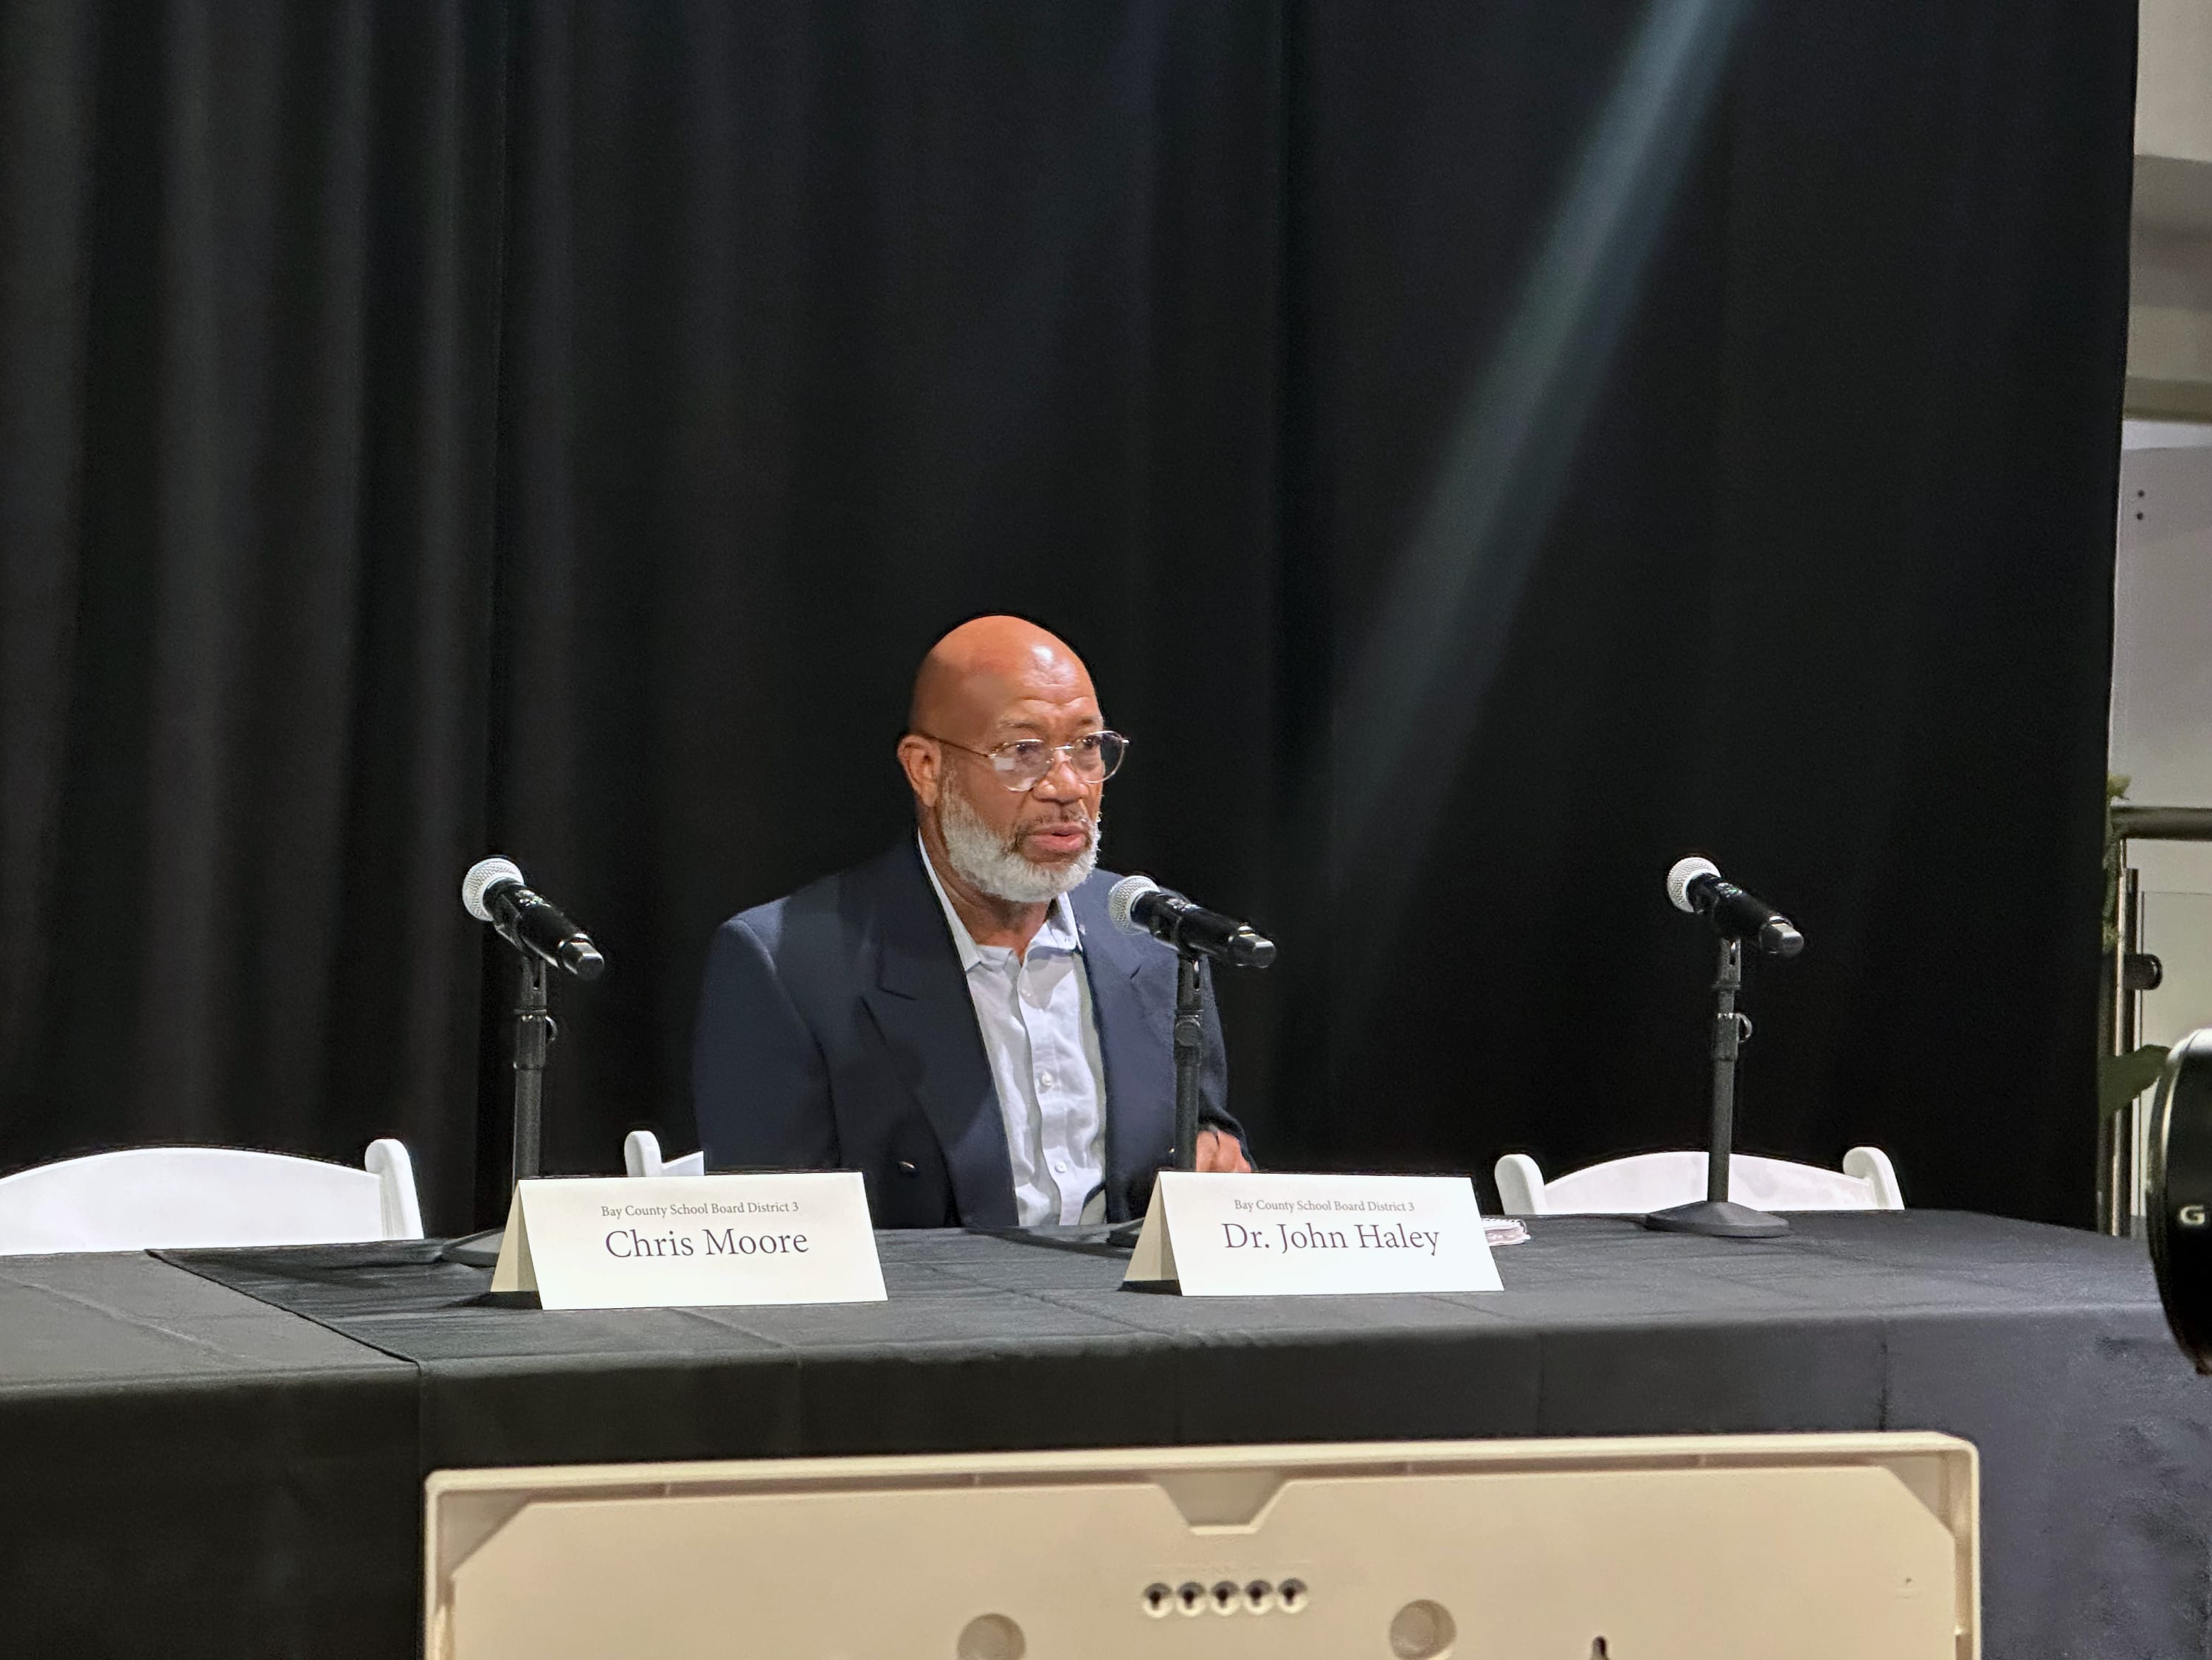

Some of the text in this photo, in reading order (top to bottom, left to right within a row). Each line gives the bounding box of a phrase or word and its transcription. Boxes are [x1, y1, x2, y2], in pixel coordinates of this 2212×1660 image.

[601, 1202, 799, 1219] Bay County School Board District 3
[1234, 1199, 1415, 1213] Bay County School Board District 3
[605, 1228, 809, 1258] Chris Moore
[1220, 1222, 1439, 1256] Dr. John Haley
